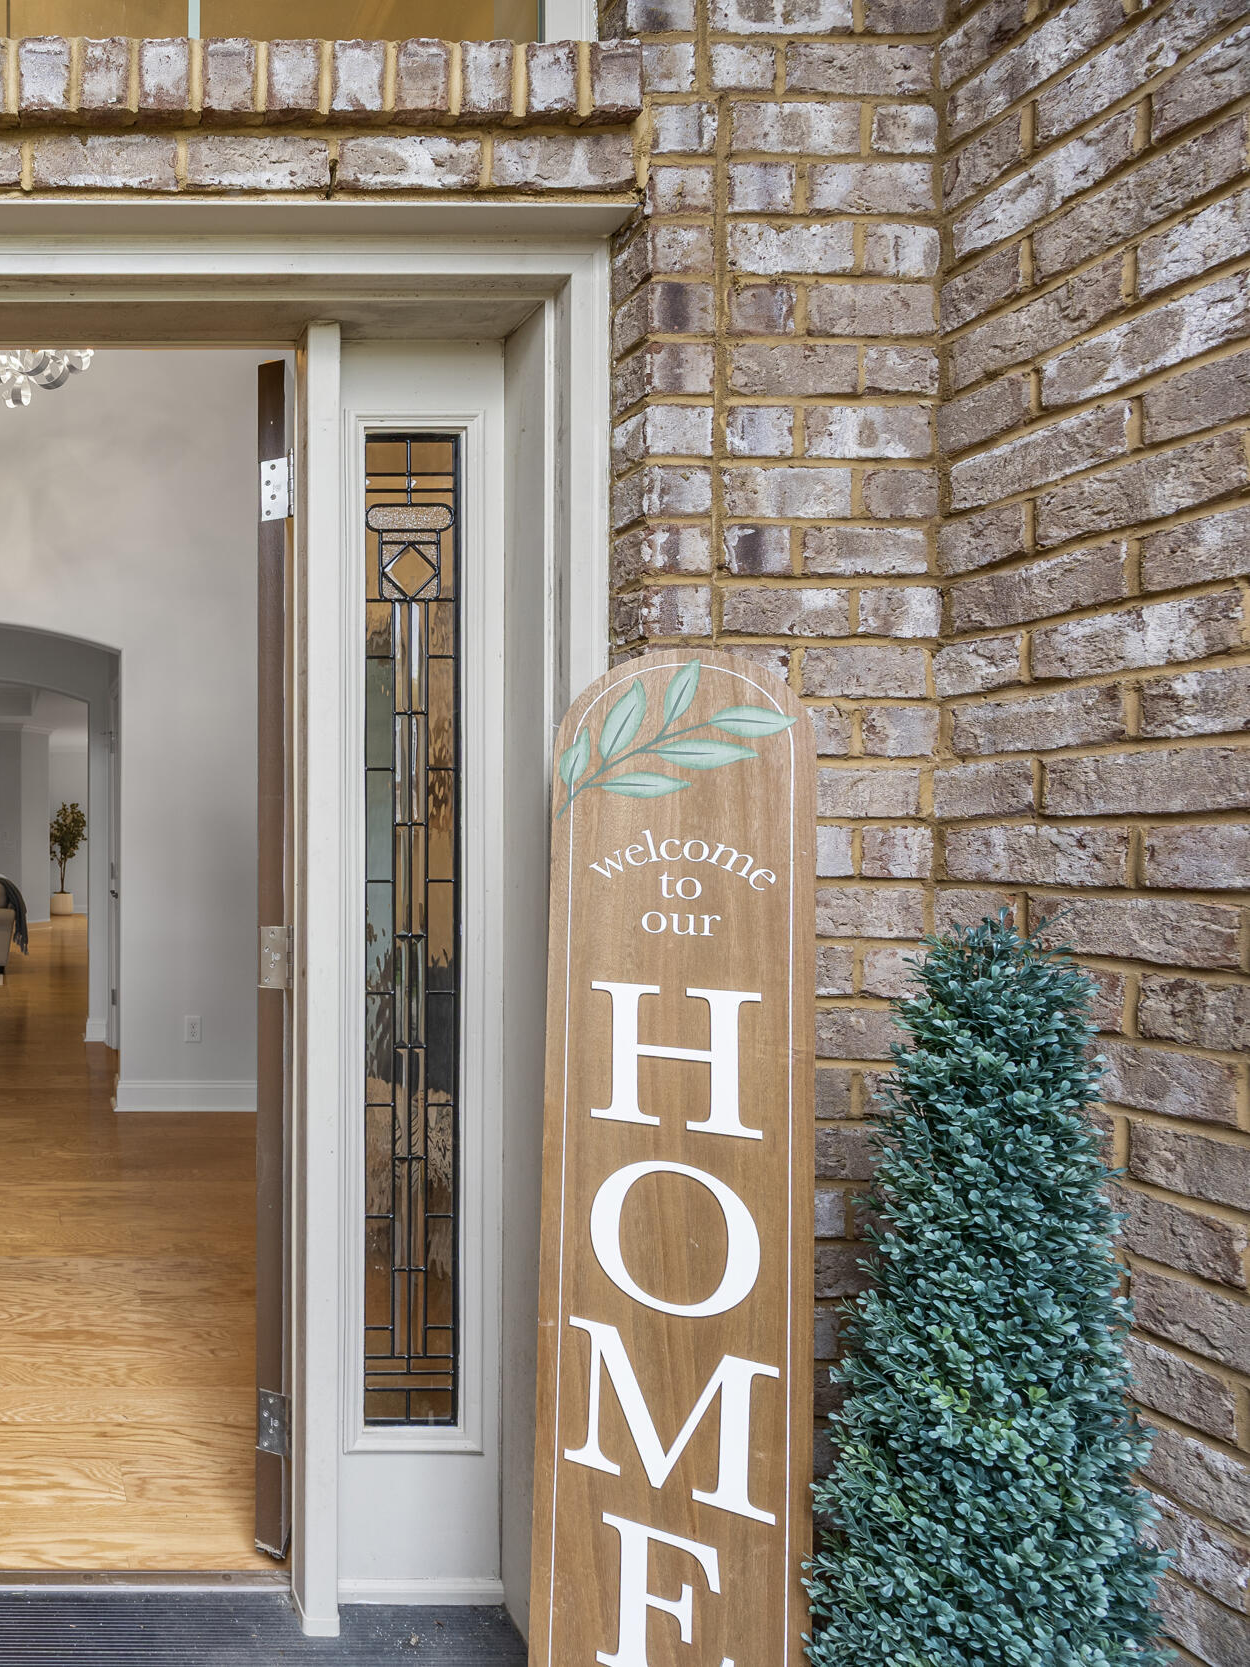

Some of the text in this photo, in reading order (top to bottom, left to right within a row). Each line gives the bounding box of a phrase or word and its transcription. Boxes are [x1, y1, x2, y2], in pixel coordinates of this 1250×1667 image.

[589, 829, 777, 892] welcome
[659, 871, 703, 900] to
[640, 910, 722, 937] our
